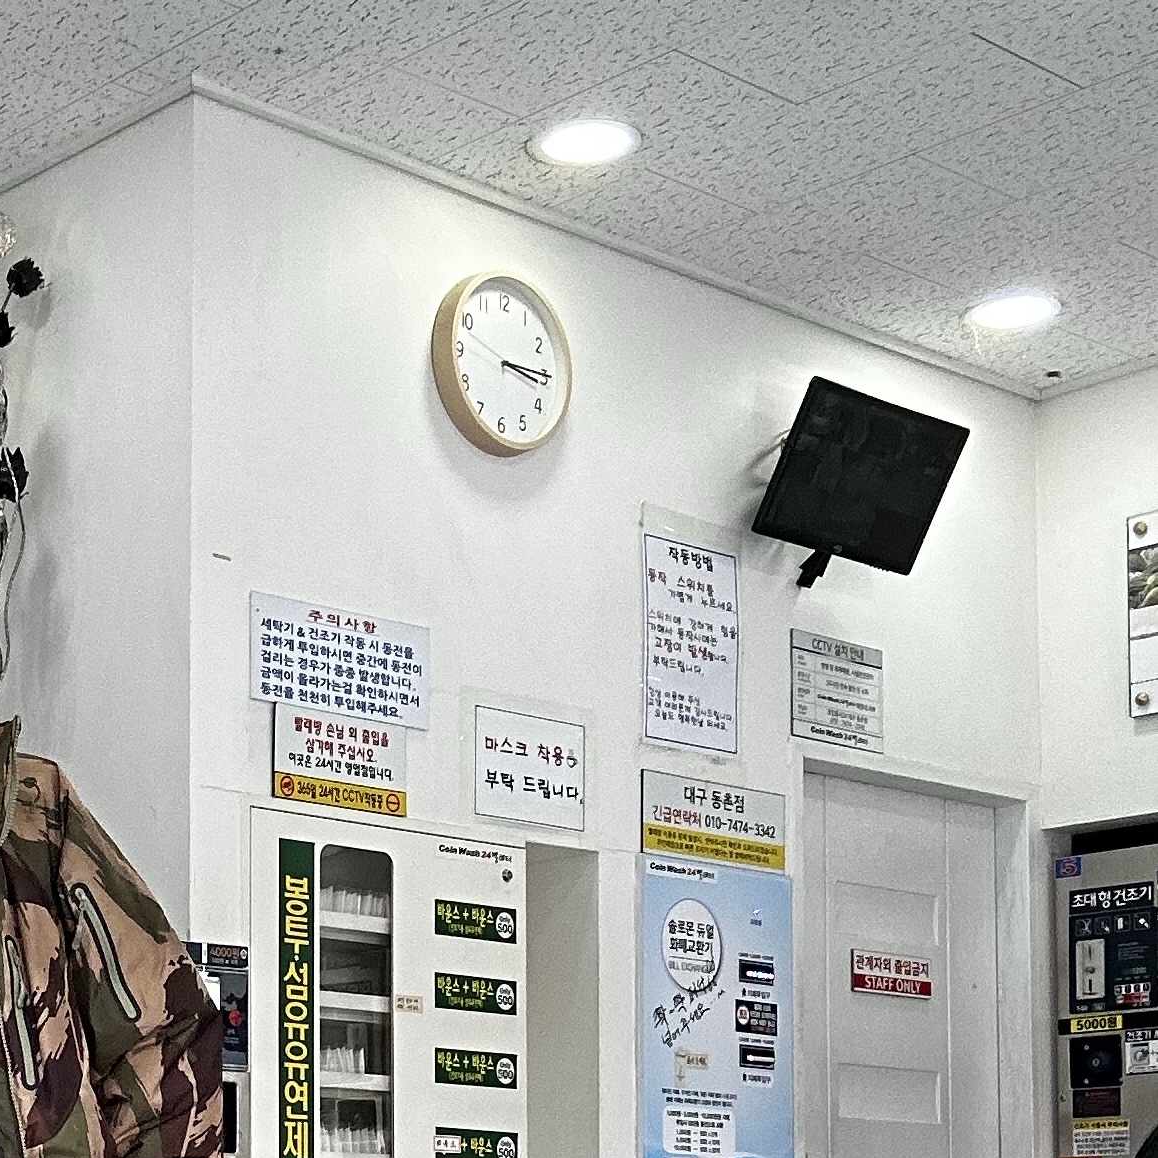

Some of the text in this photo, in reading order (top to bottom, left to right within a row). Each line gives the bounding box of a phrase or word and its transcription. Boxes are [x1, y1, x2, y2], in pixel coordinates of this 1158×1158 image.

[499, 293, 510, 313] 12
[462, 312, 473, 330] 10
[455, 341, 464, 357] 9
[535, 337, 542, 354] 2
[462, 374, 469, 391] 8
[534, 398, 542, 414] 4
[497, 416, 506, 433] 6
[519, 415, 527, 431] 5
[261, 618, 294, 635] 세탁기
[308, 627, 341, 645] 건조기
[811, 637, 833, 653] CCTV
[261, 633, 422, 677] 급하게 투입하시면 중간에 동전이
[298, 657, 332, 675] 경우가
[260, 666, 420, 708] 금액이 확인하시면서
[298, 688, 331, 706] 천천히
[326, 722, 344, 739] 손님
[485, 736, 529, 757] 마스크
[484, 768, 515, 793] 부탁
[683, 786, 745, 814] 대구 동촌점
[651, 804, 776, 839] 긴급연락처 010-7474-3342
[1071, 885, 1152, 909] 초대형건조기
[668, 919, 715, 940] 솔로몬 듀얼
[669, 937, 714, 957] 화폐교환기
[855, 954, 929, 978] 관계자외 출입금지
[864, 975, 921, 994] STAFF ONLY
